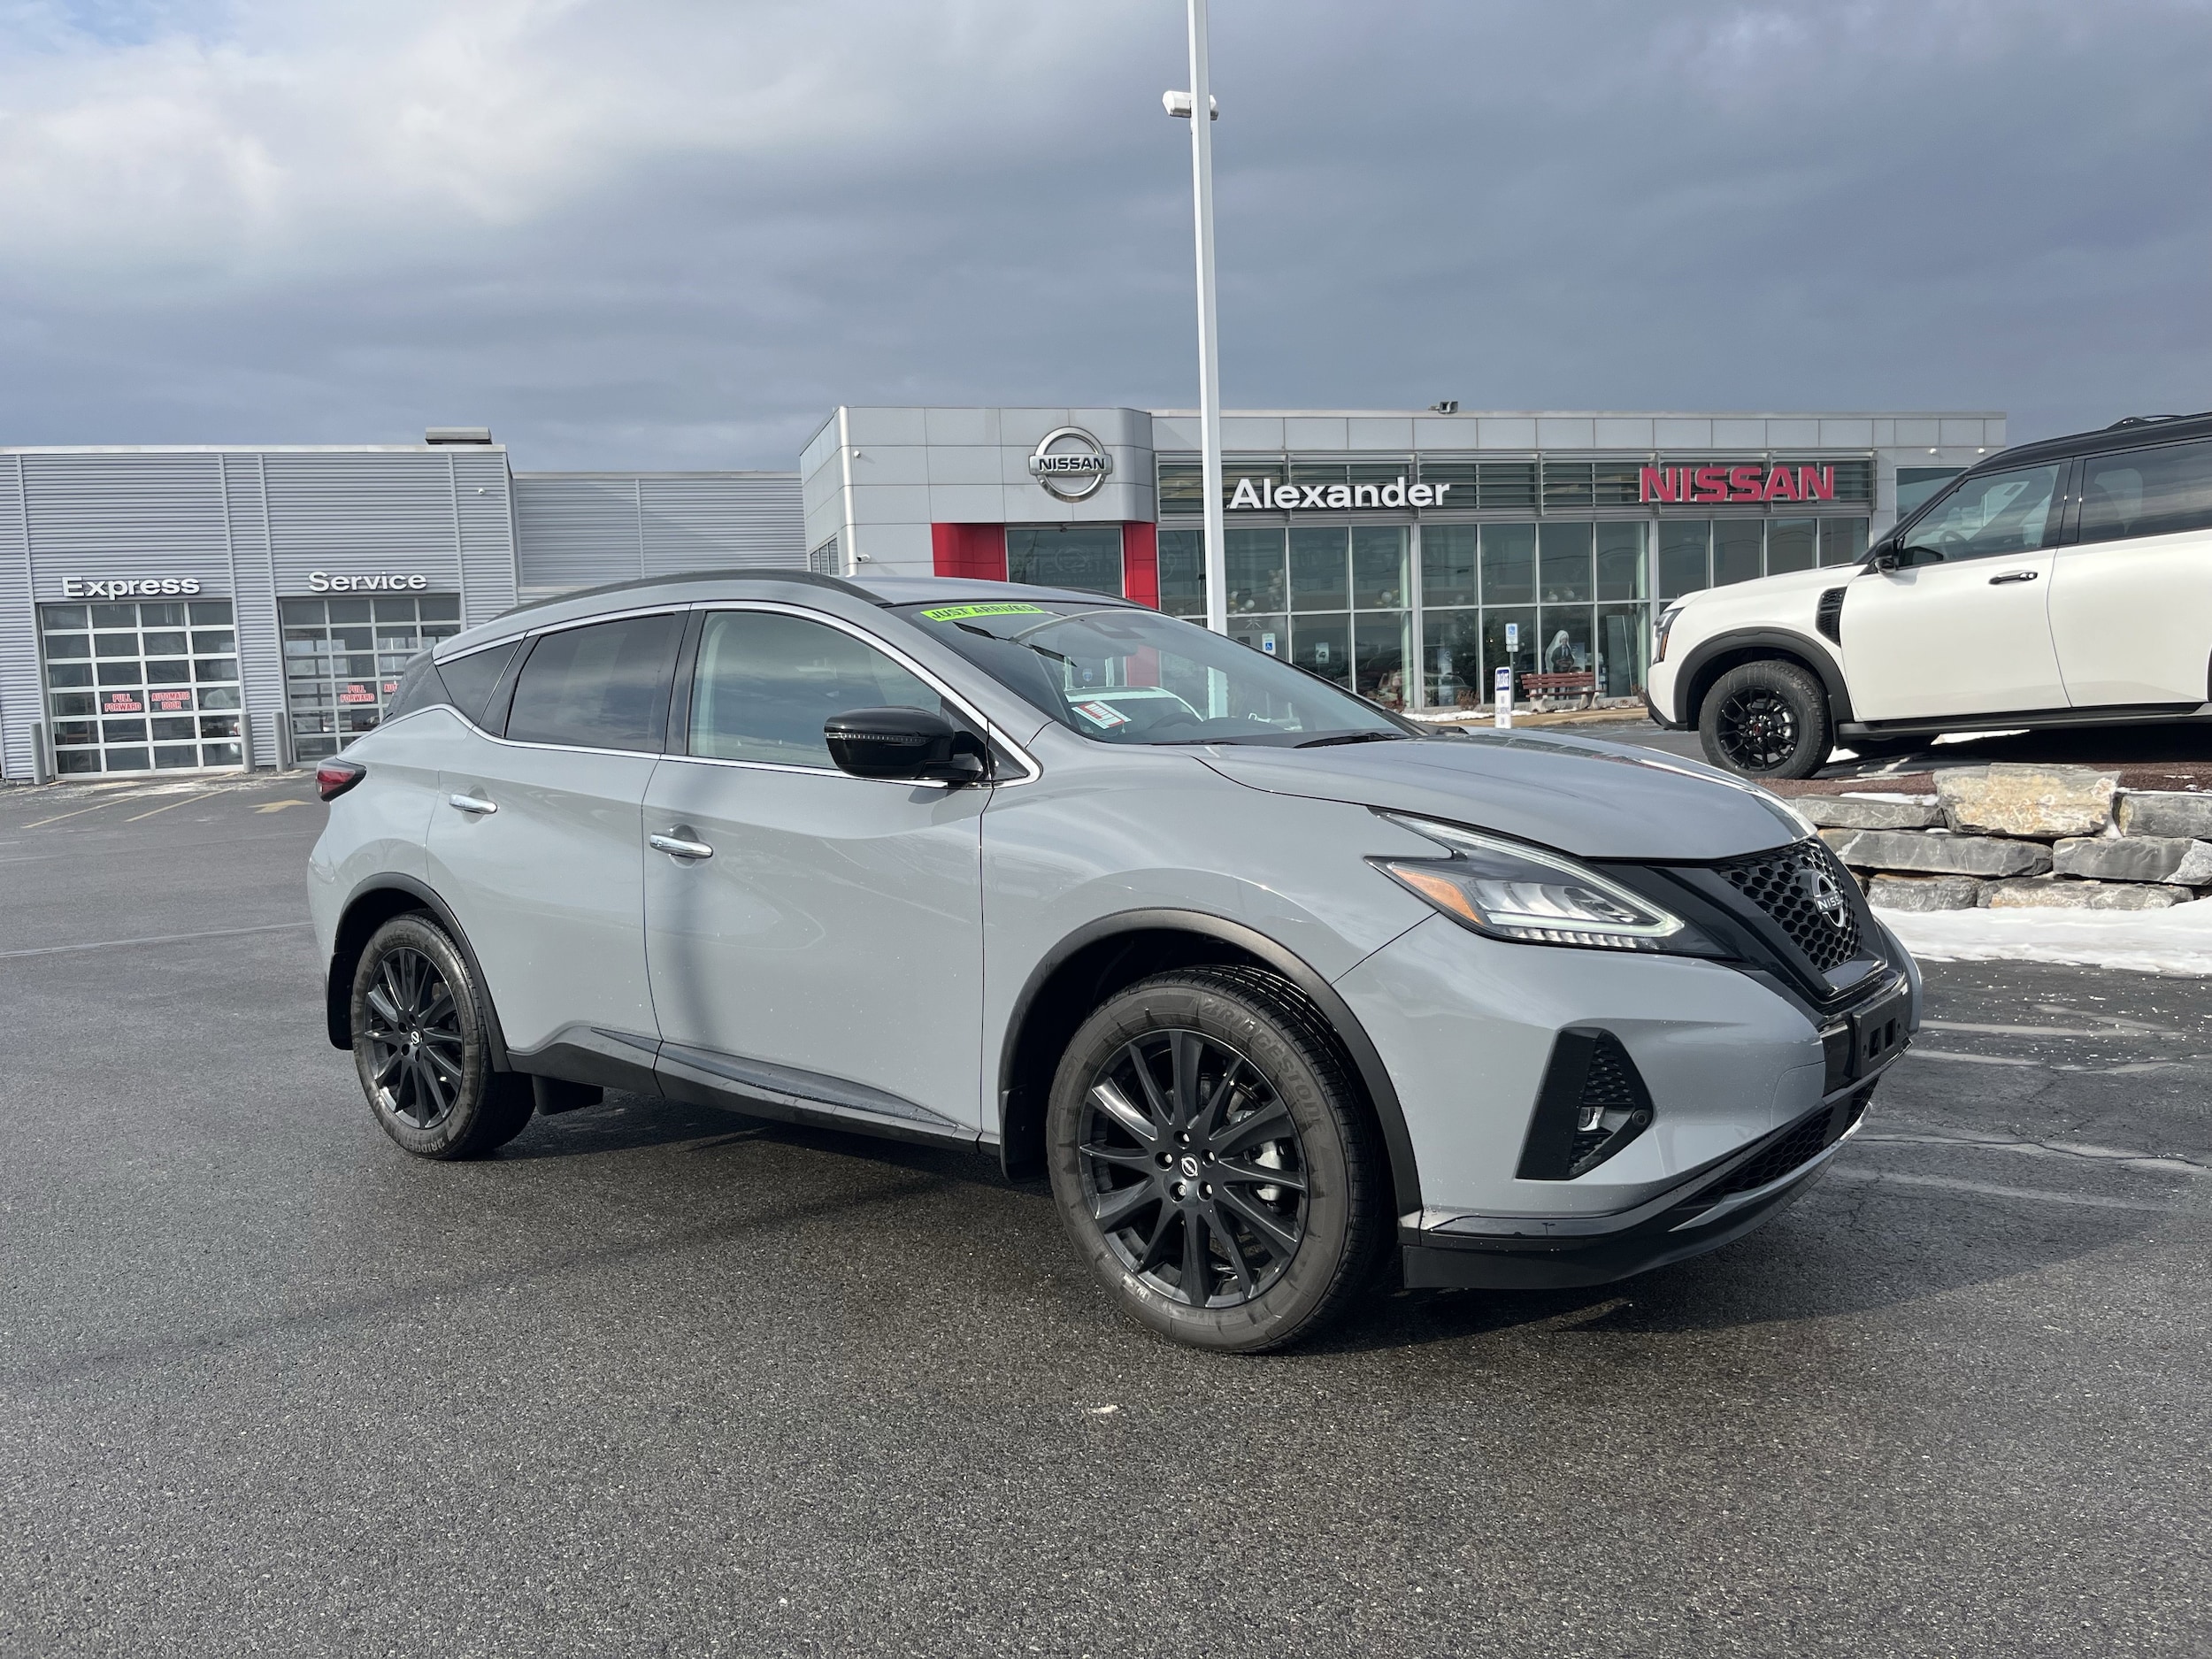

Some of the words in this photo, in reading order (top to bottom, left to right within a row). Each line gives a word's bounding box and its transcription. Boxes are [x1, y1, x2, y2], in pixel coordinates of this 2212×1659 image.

[1039, 457, 1105, 471] NISSAN
[1639, 466, 1834, 503] NISSAN
[1229, 476, 1450, 509] Alexander
[62, 576, 200, 601] Express
[309, 571, 427, 592] Service
[931, 608, 969, 618] JUST
[972, 603, 1037, 613] ARRIVED
[151, 691, 190, 702] AUTOMATIC
[347, 685, 366, 694] PULL
[112, 694, 133, 703] PULL
[340, 693, 375, 703] FORWARD
[104, 702, 142, 711] FORWARD
[161, 701, 182, 710] DOOR
[1816, 895, 1840, 910] NISS
